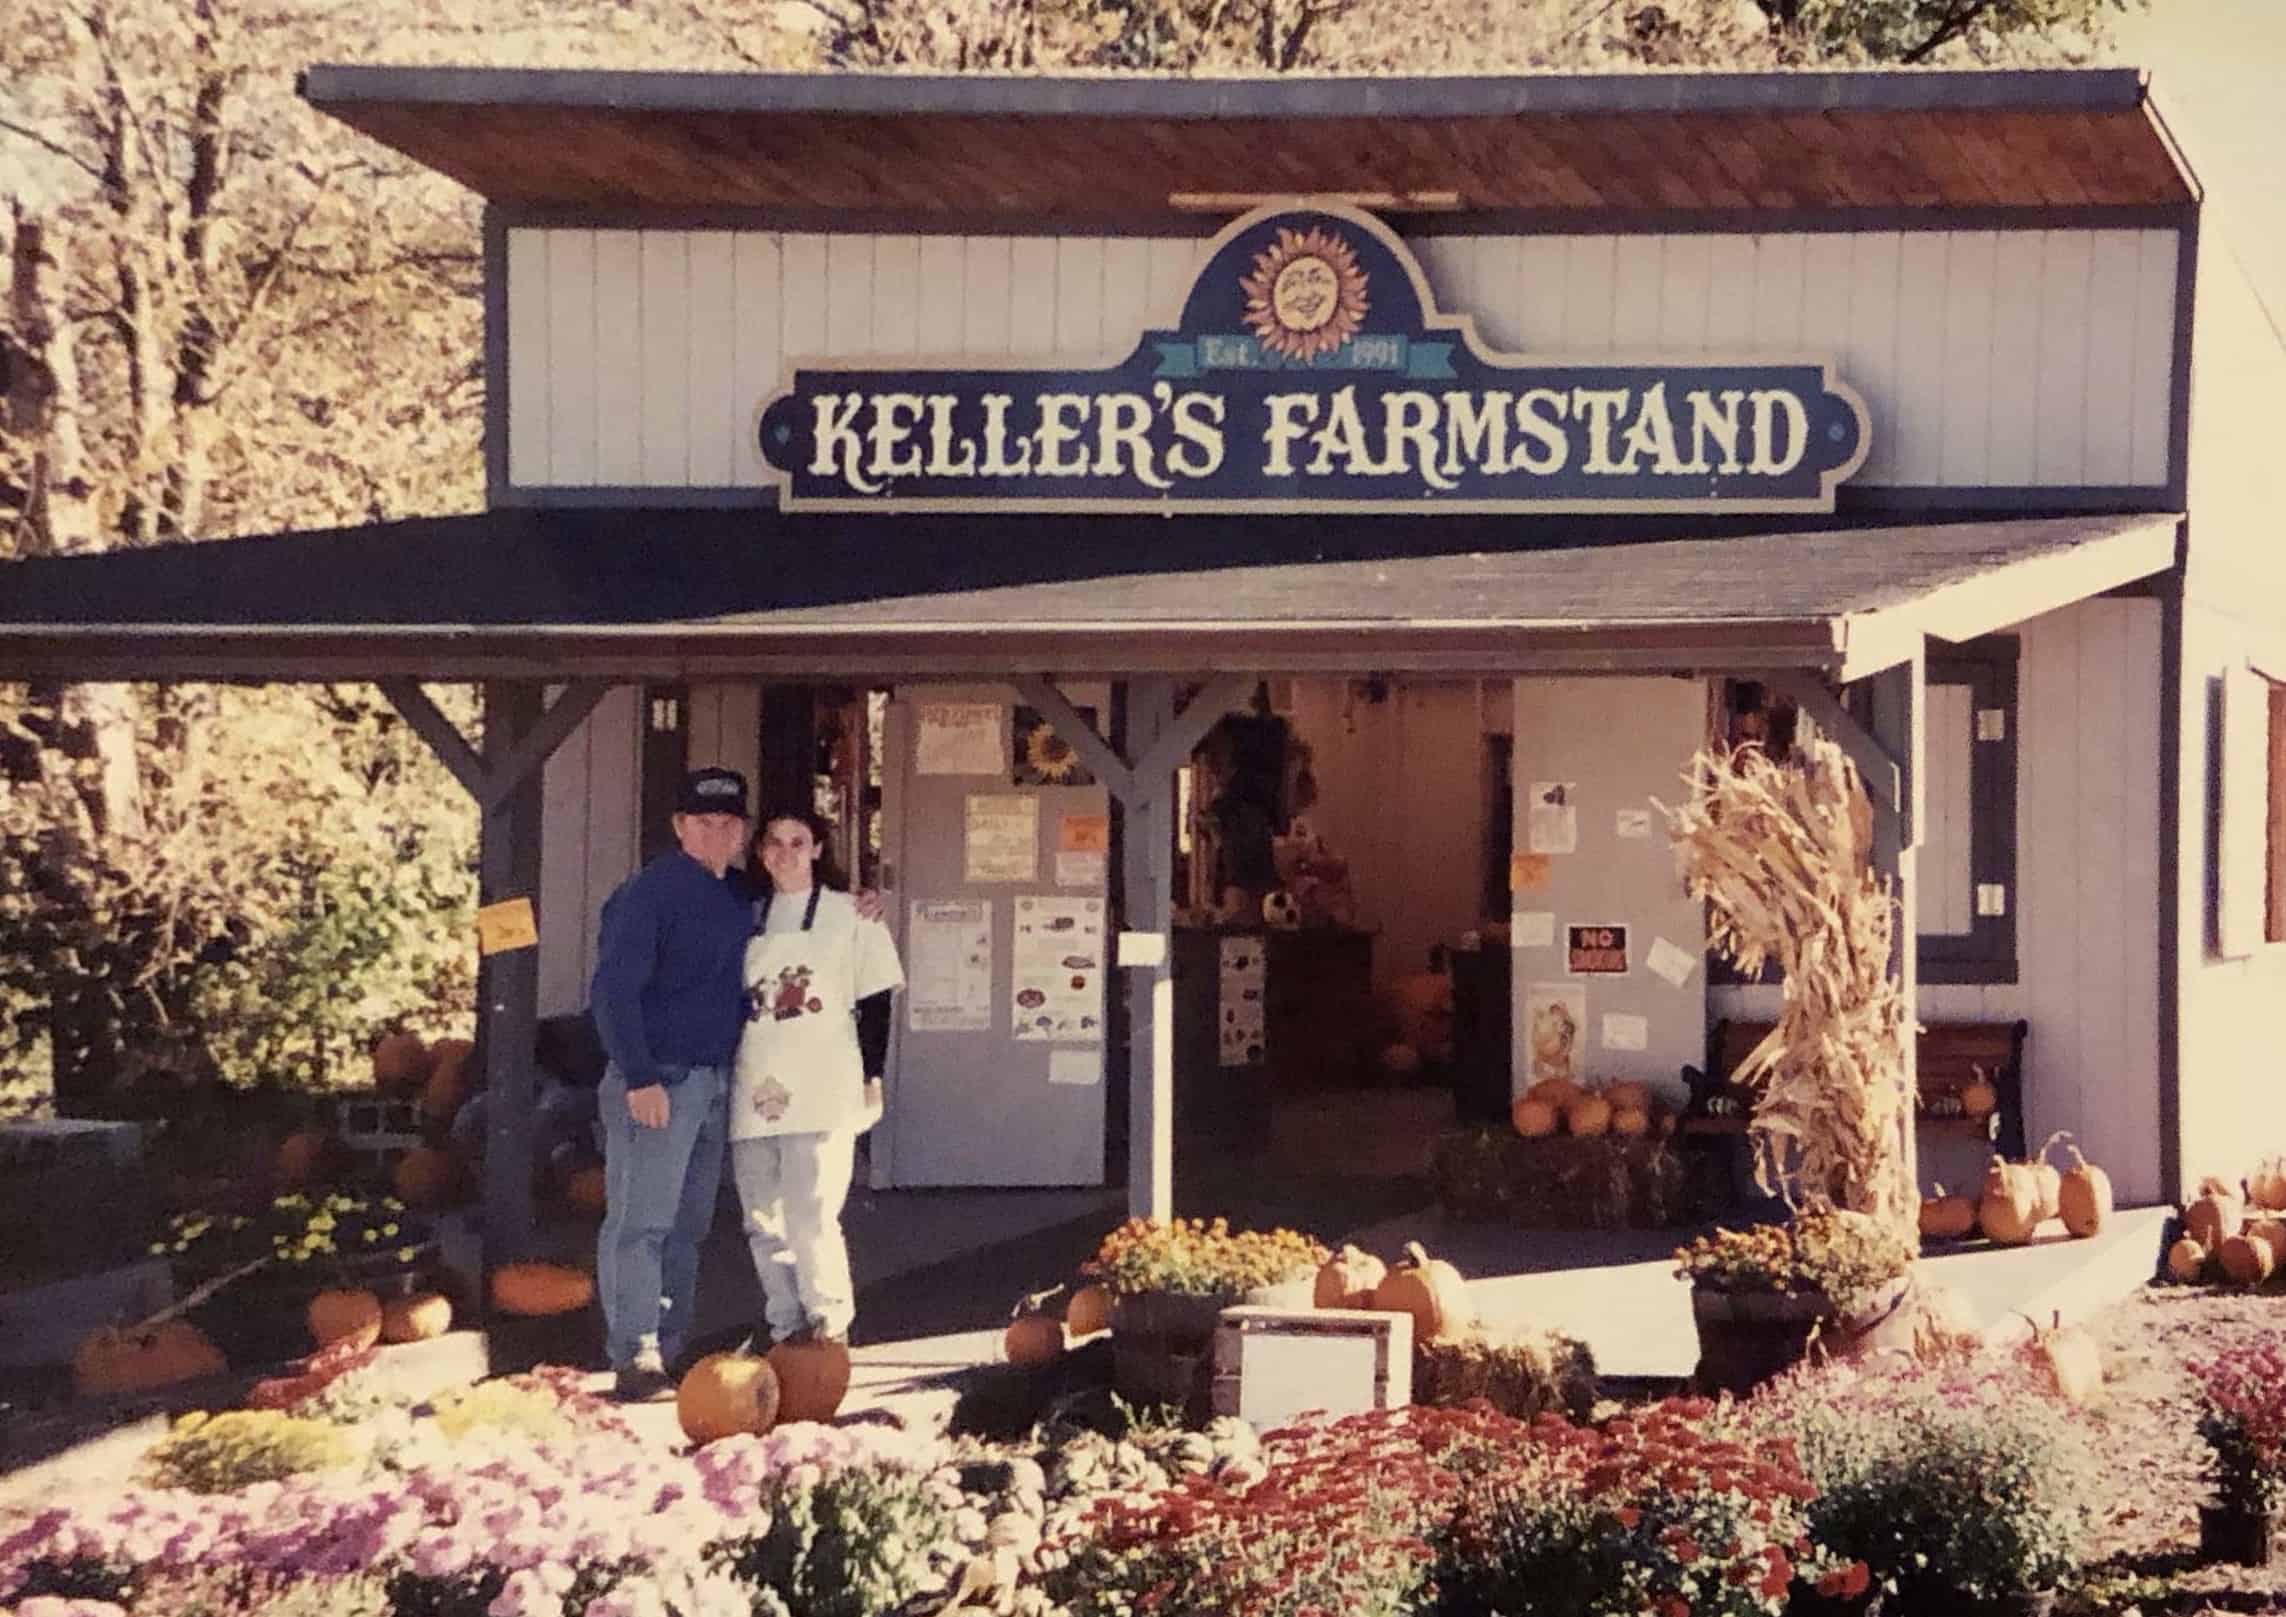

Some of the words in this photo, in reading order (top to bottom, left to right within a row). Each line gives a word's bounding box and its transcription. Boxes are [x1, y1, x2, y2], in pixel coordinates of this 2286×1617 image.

[808, 381, 1225, 493] KELLER'S
[1262, 382, 1808, 490] FARMSTAND
[1582, 930, 1613, 947] NO
